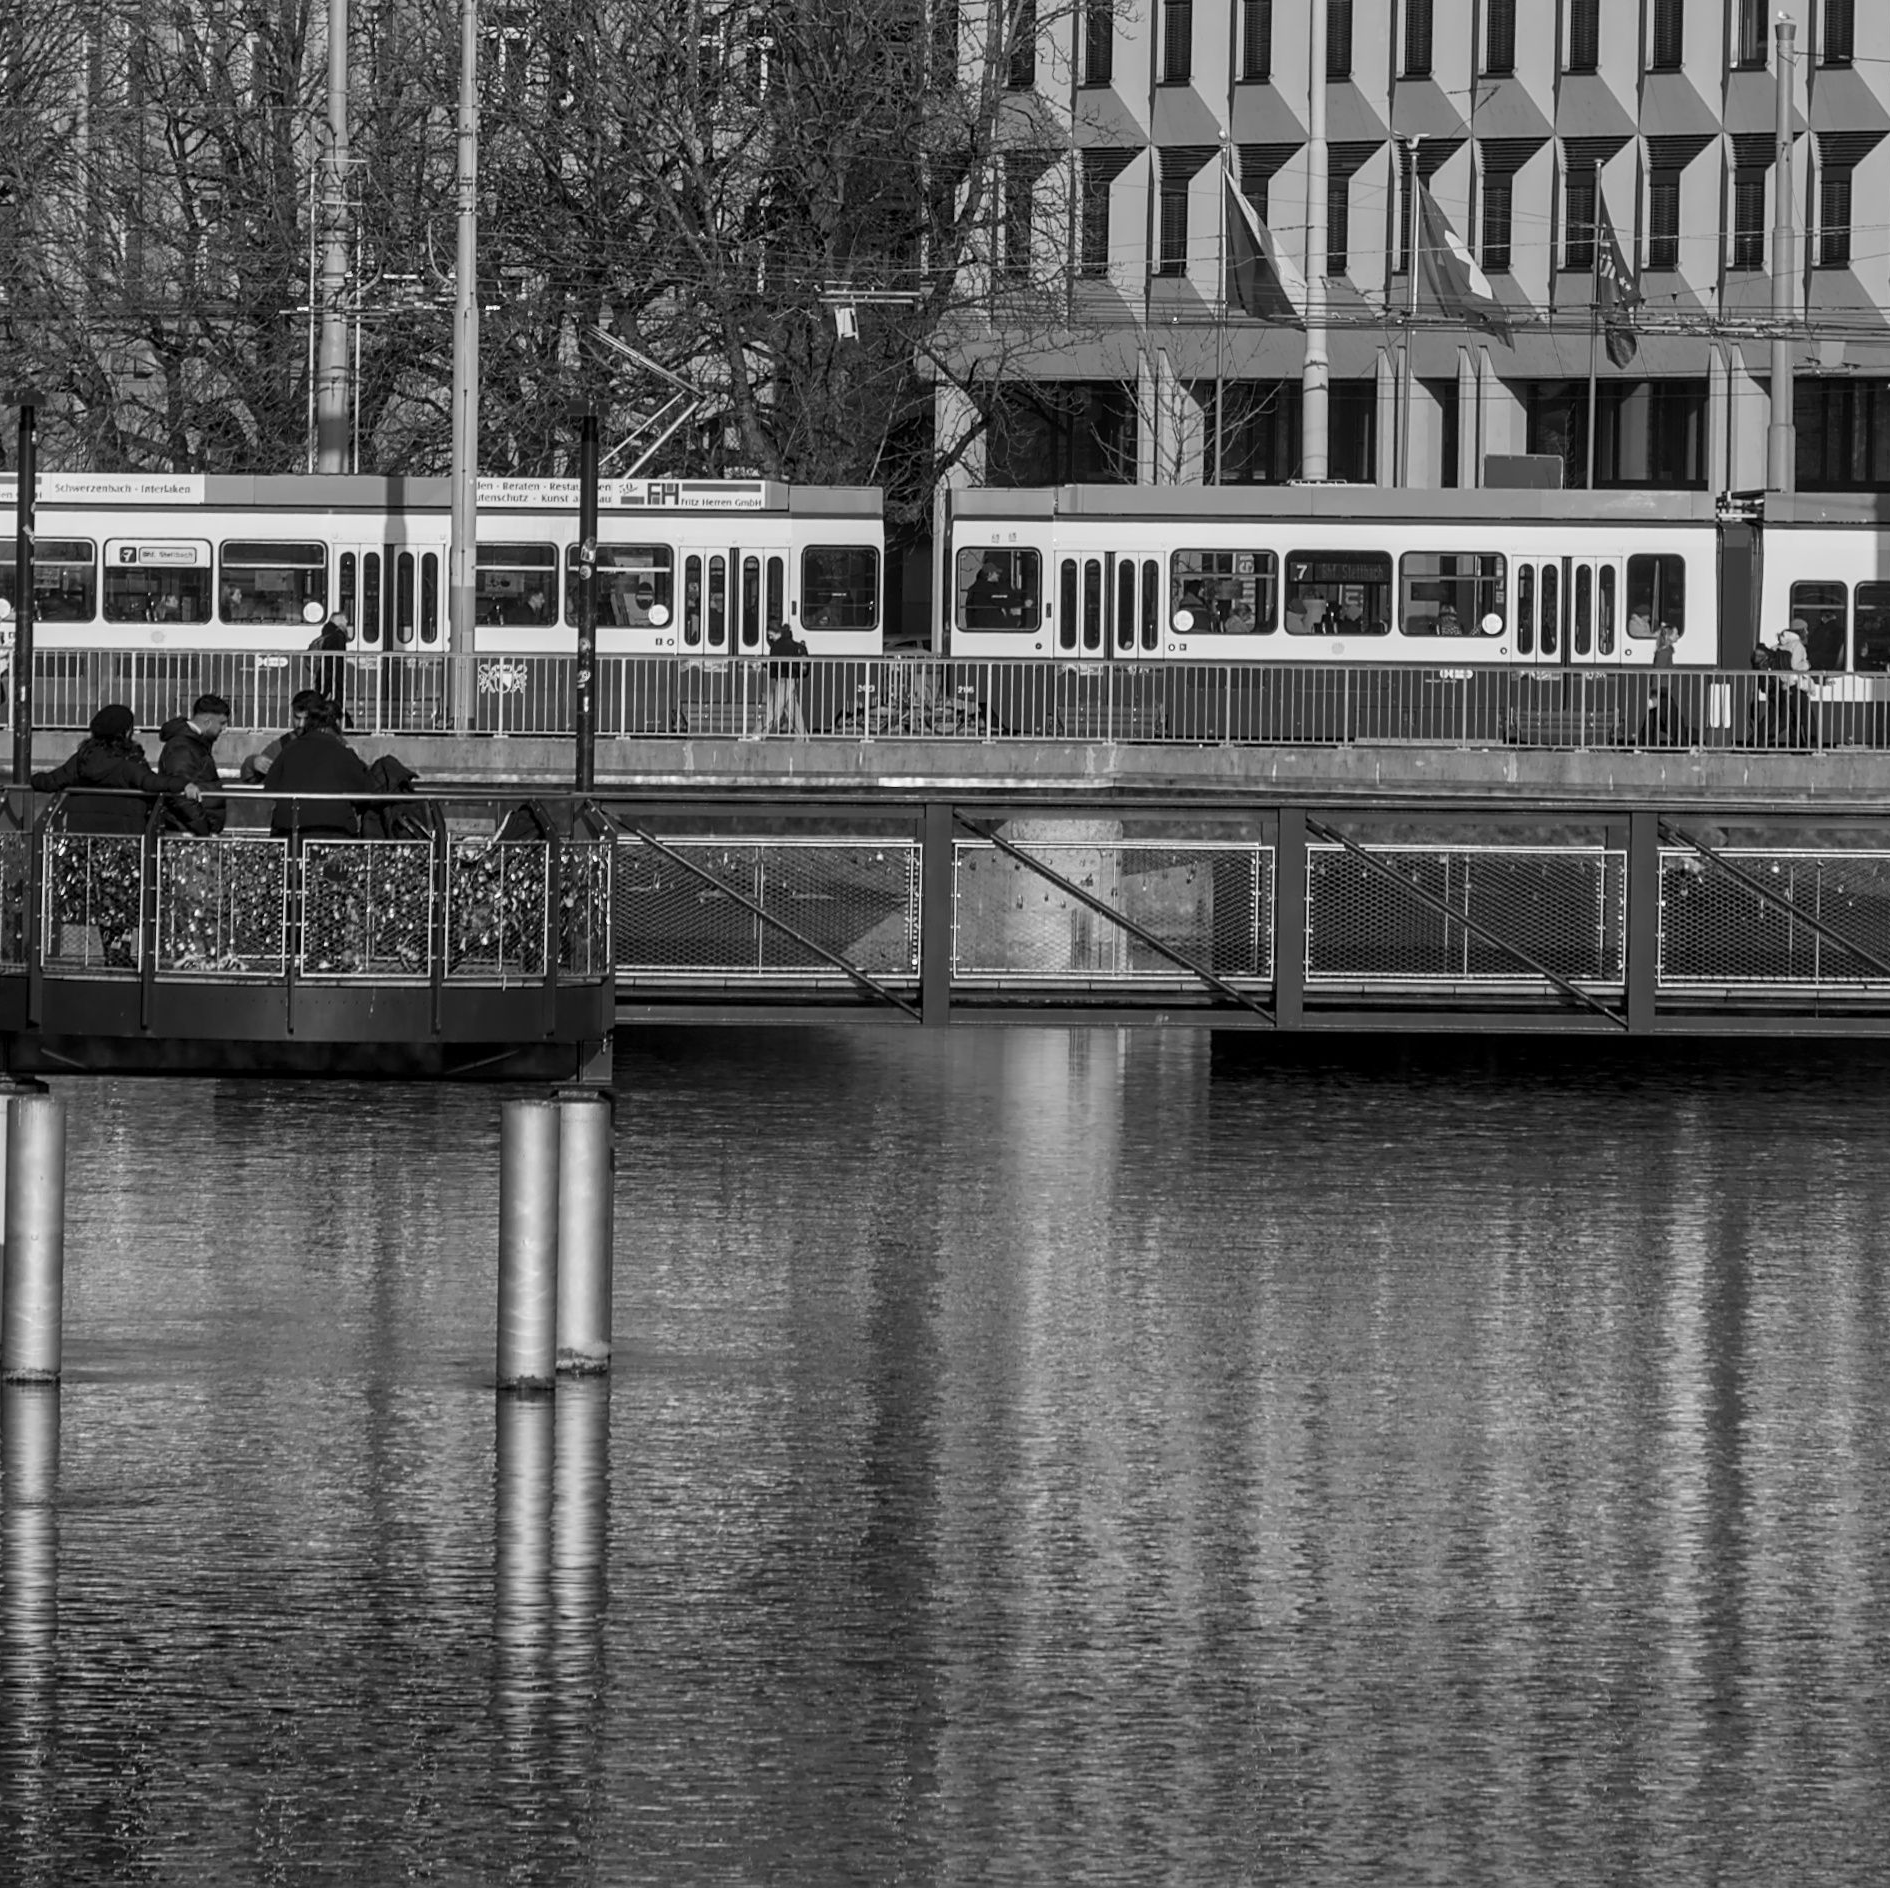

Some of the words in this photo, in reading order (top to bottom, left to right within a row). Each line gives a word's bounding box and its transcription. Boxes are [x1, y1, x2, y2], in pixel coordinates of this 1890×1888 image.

[54, 483, 132, 493] Schwerzenbach
[502, 481, 540, 491] Beraten
[541, 494, 568, 503] Kunst
[647, 482, 680, 505] FH
[681, 497, 699, 506] Fritz
[702, 498, 732, 507] Herren
[734, 498, 762, 507] GmbH
[1296, 564, 1308, 580] 7
